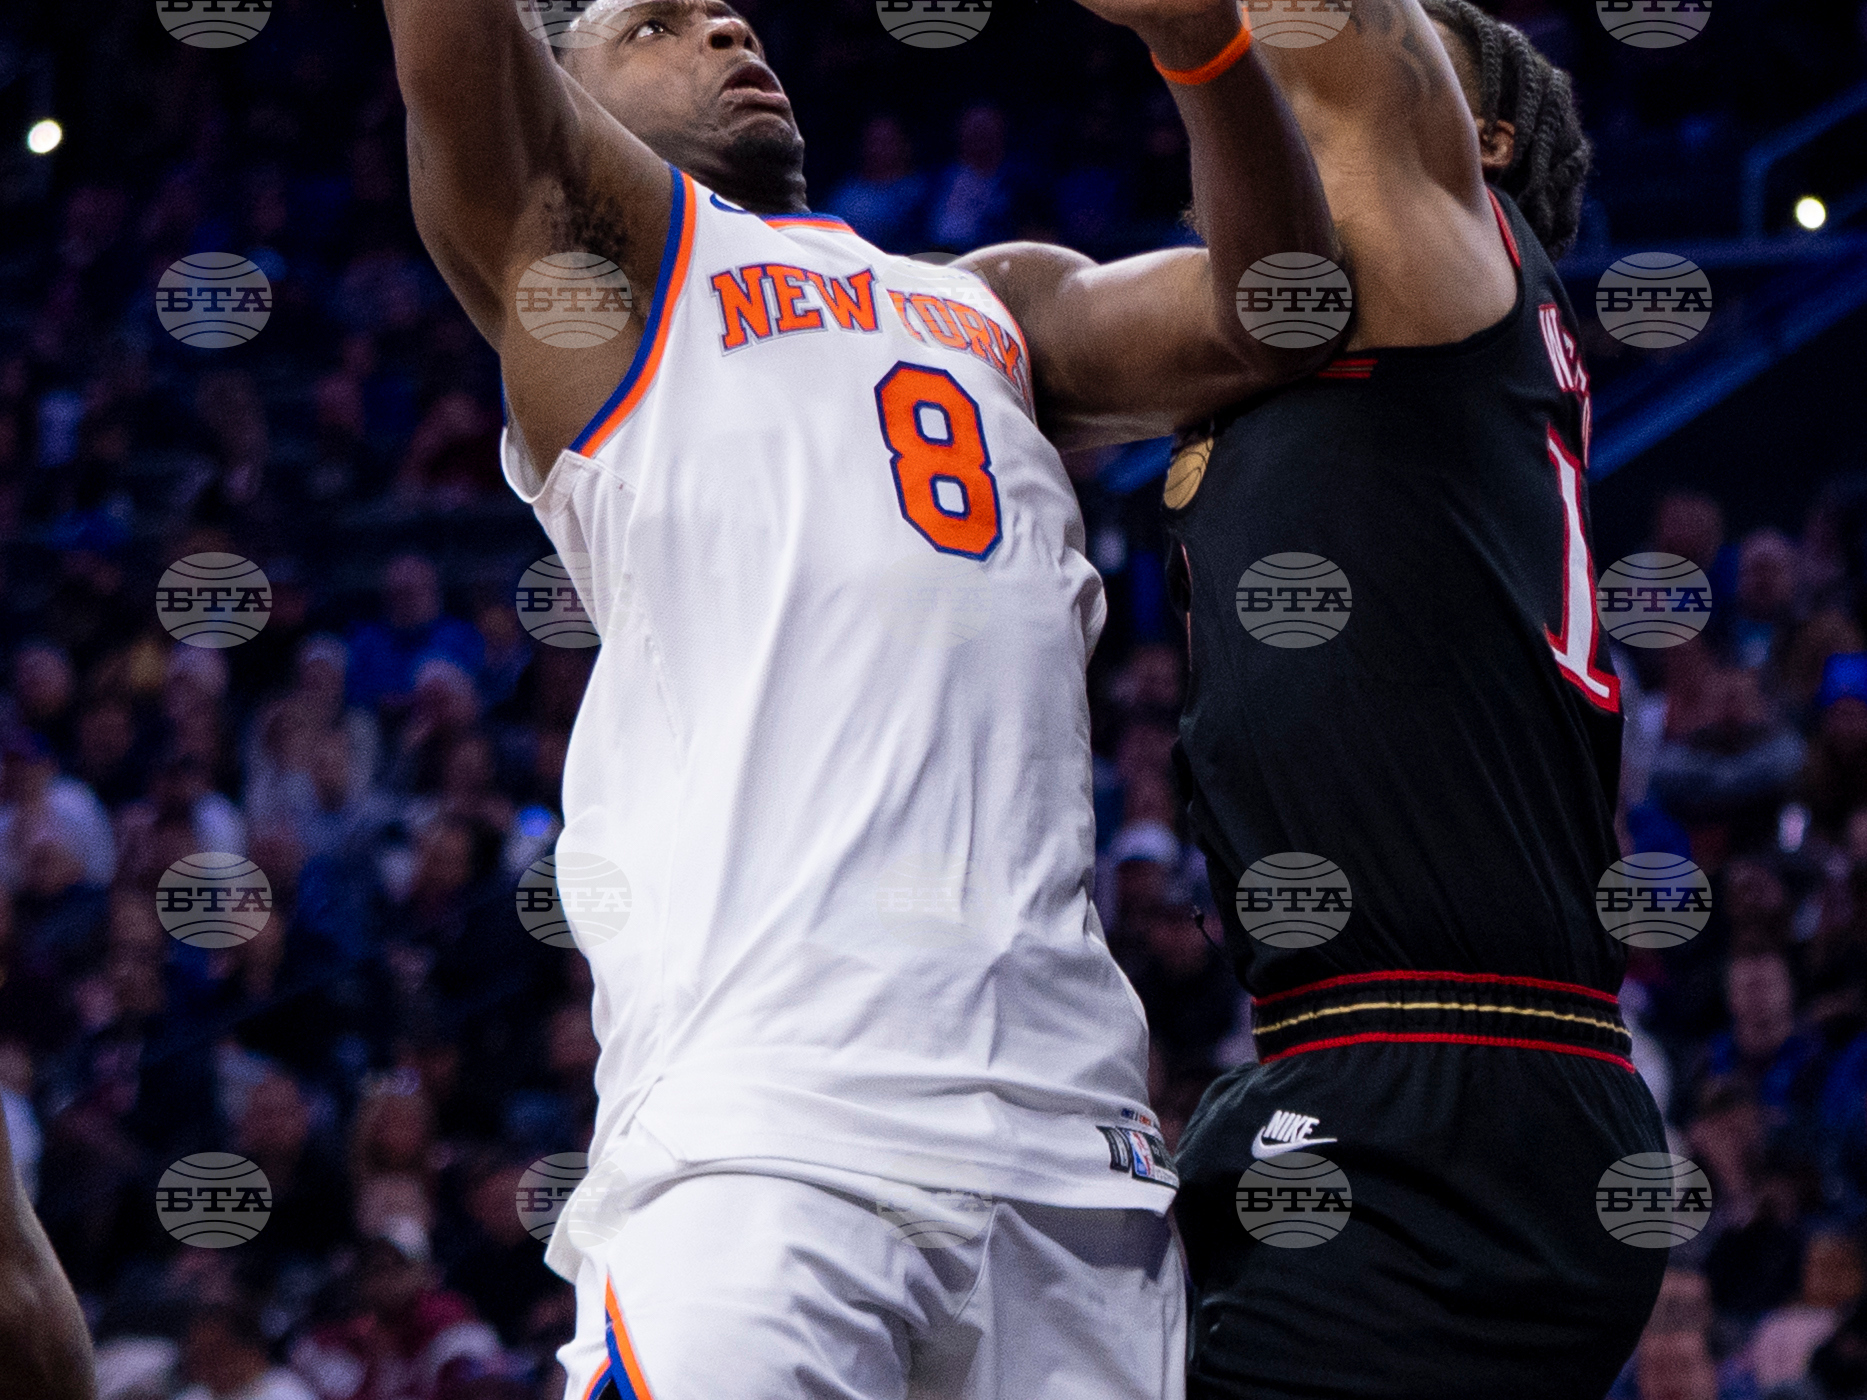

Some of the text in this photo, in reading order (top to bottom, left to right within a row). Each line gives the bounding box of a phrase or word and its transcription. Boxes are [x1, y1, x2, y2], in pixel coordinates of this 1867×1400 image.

[707, 260, 877, 358] NEW
[874, 360, 1003, 562] 8
[1263, 1109, 1321, 1143] NIKE
